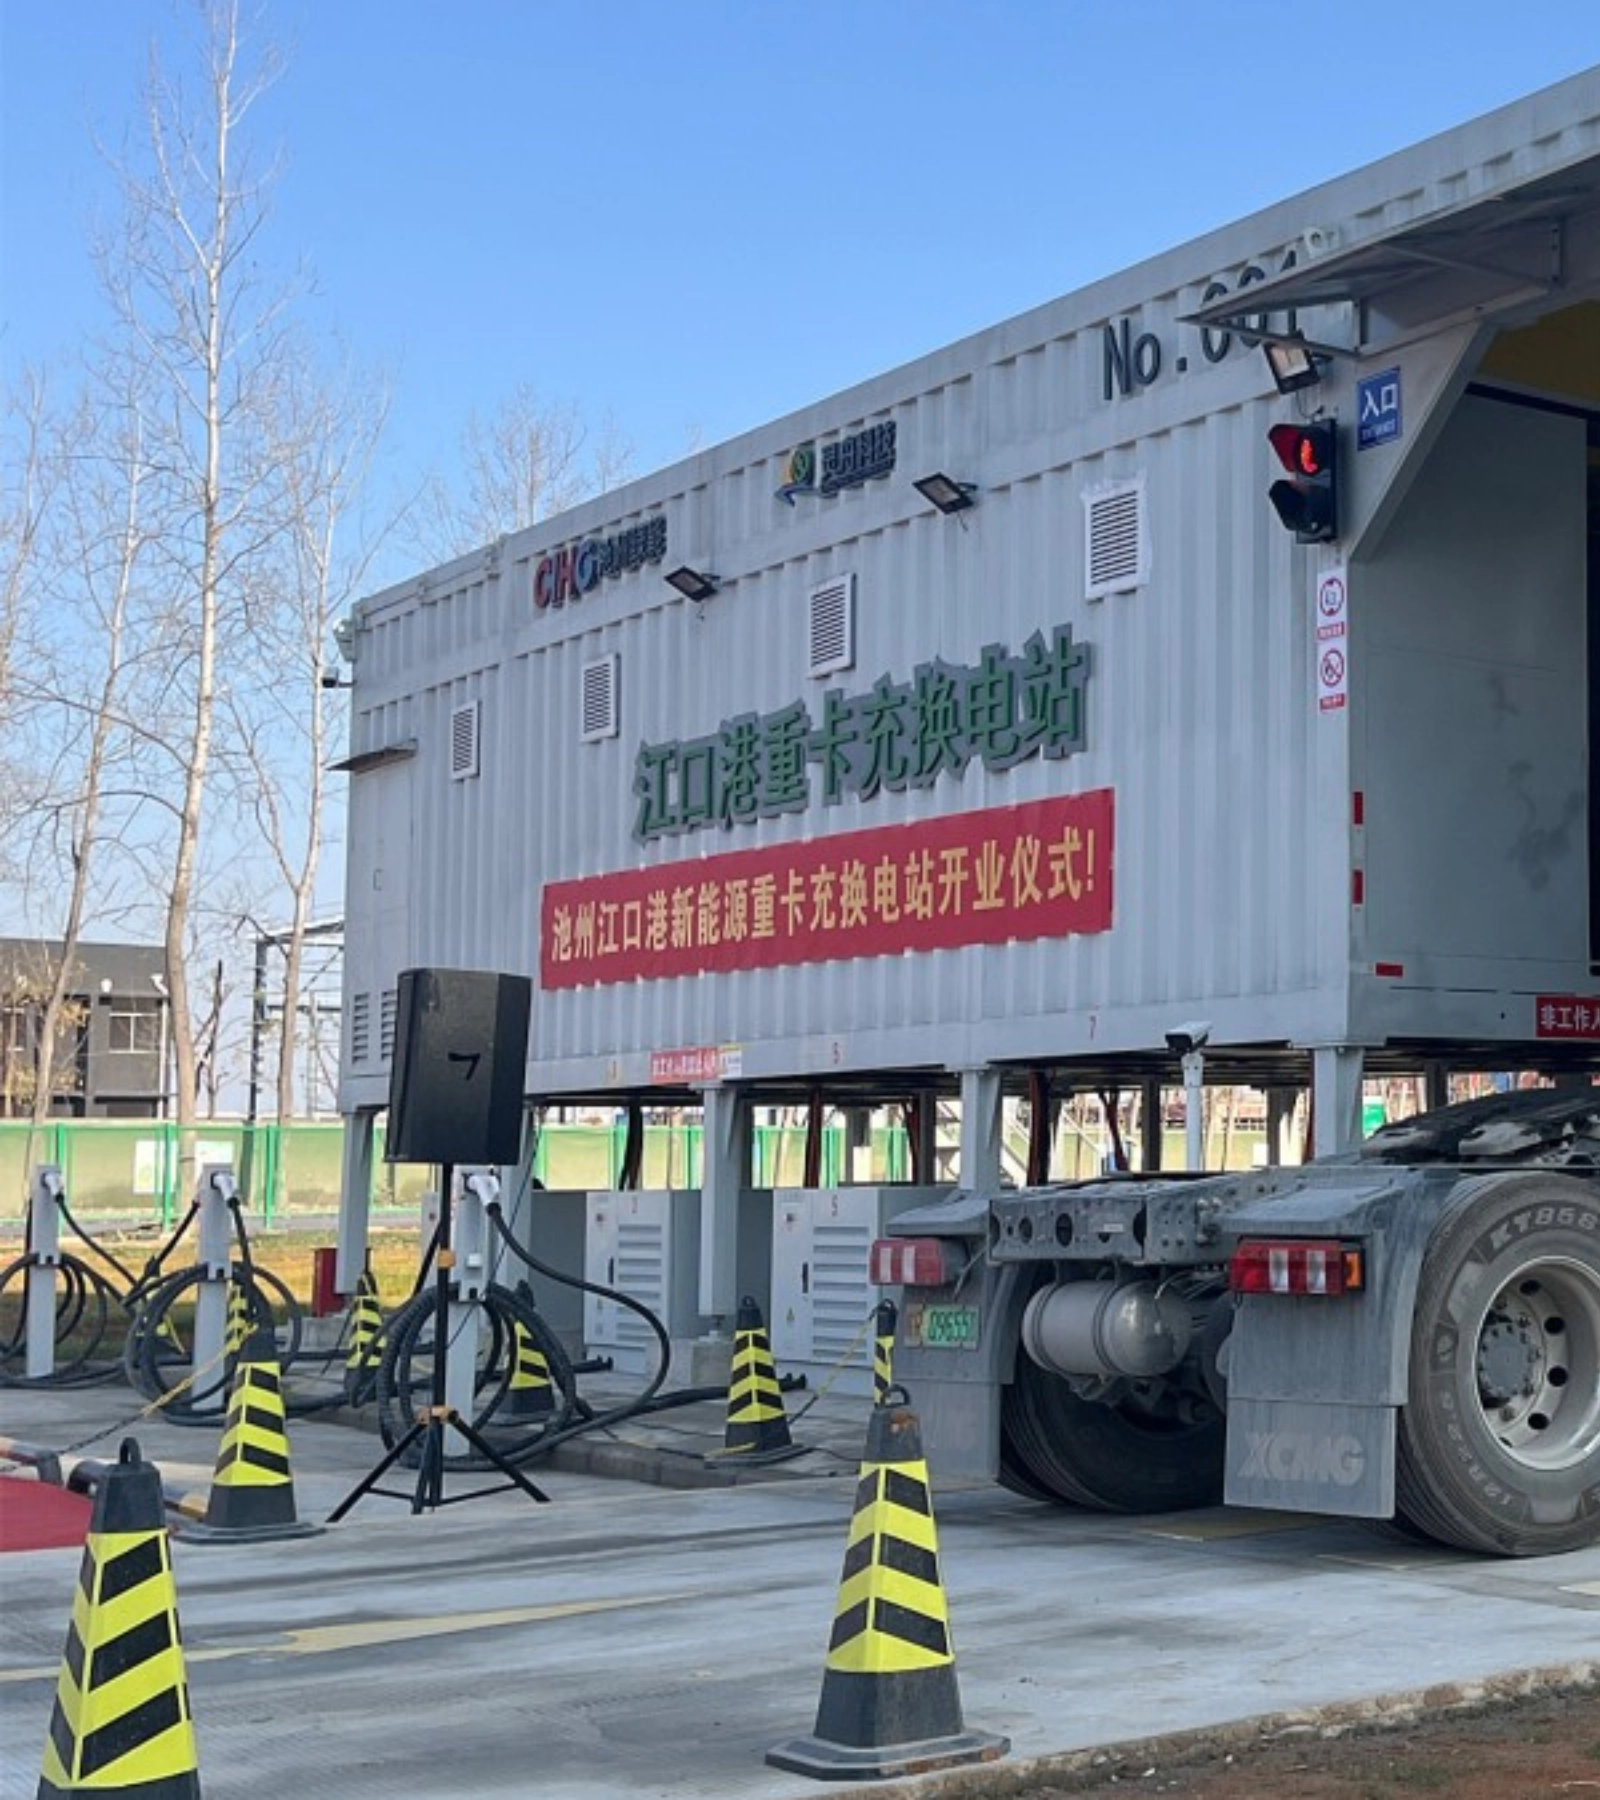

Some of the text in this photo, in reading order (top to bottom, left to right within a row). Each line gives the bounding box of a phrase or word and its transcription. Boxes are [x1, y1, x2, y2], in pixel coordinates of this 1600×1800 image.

[1362, 383, 1398, 422] 入口
[634, 624, 1092, 842] 江口港重卡充换电站
[447, 1052, 481, 1081] 7
[1236, 1430, 1366, 1487] XCMG
